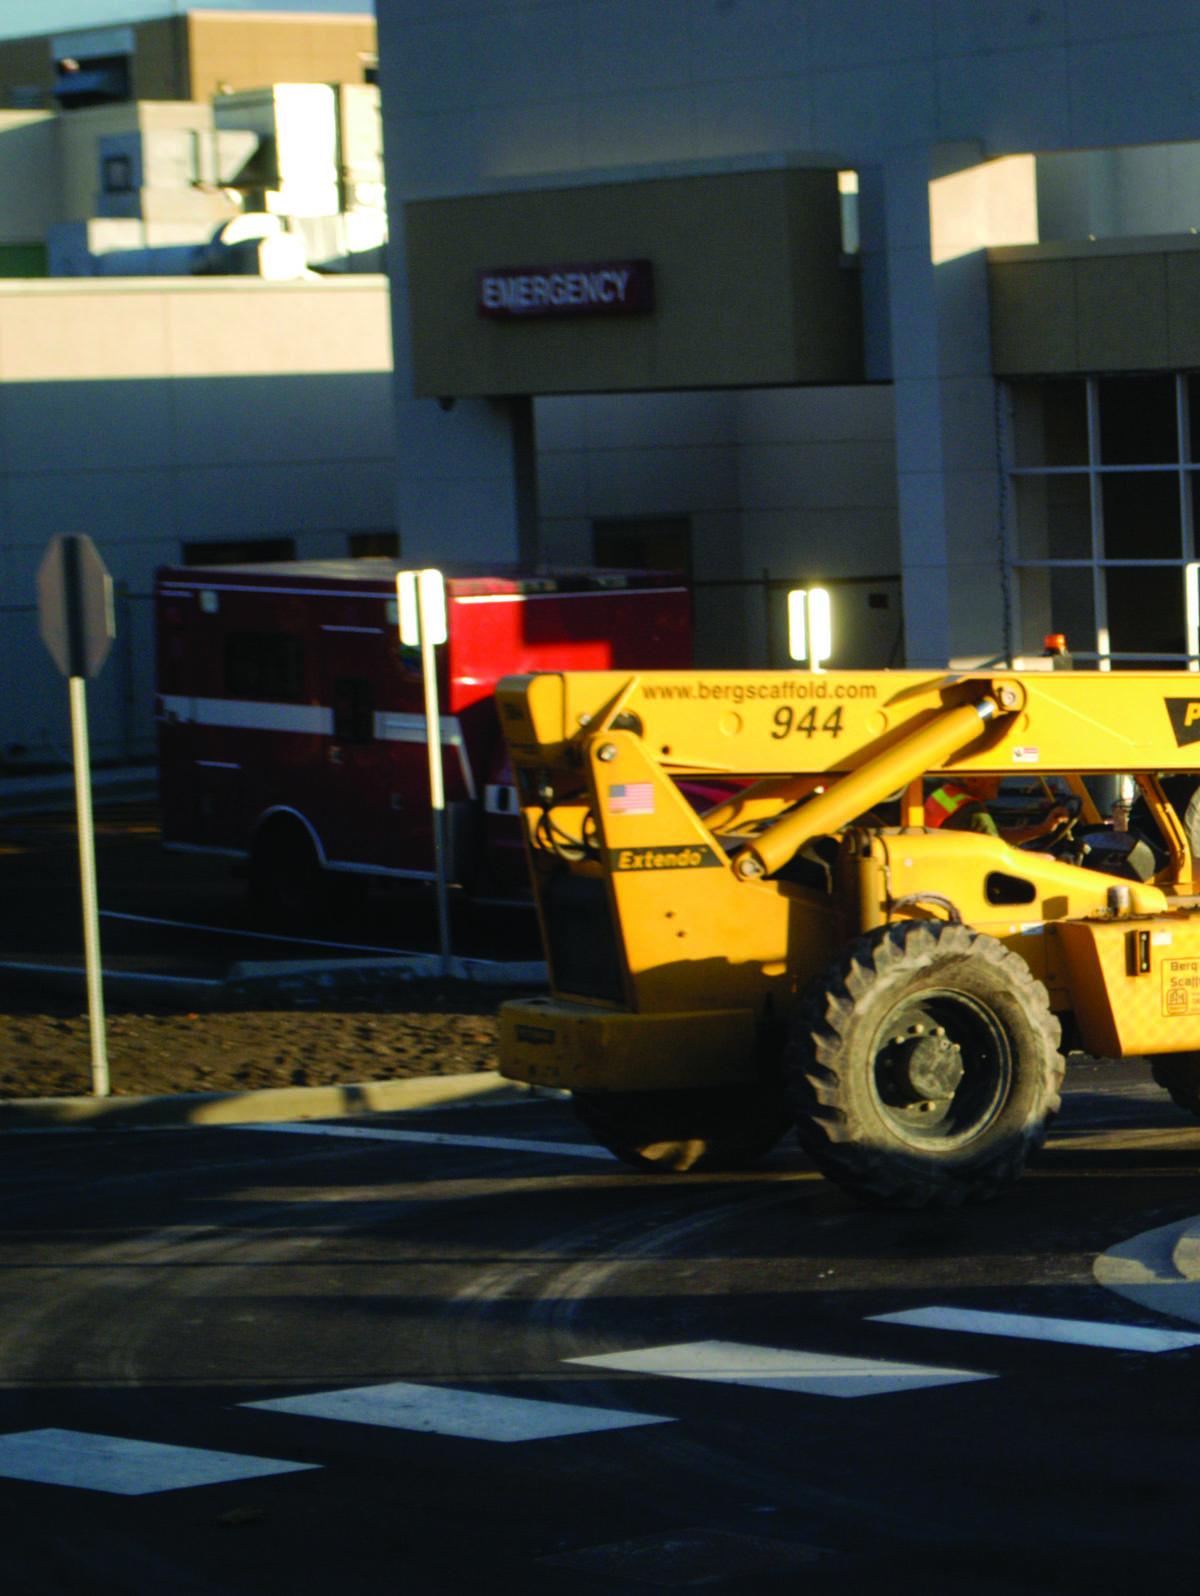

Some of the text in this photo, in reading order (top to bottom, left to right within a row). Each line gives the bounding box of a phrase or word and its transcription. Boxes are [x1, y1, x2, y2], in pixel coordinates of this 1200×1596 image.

[482, 270, 630, 308] EMERGENCY
[642, 681, 877, 703] www.bergscaffold.com
[771, 705, 843, 739] 944
[619, 848, 702, 869] Extendo
